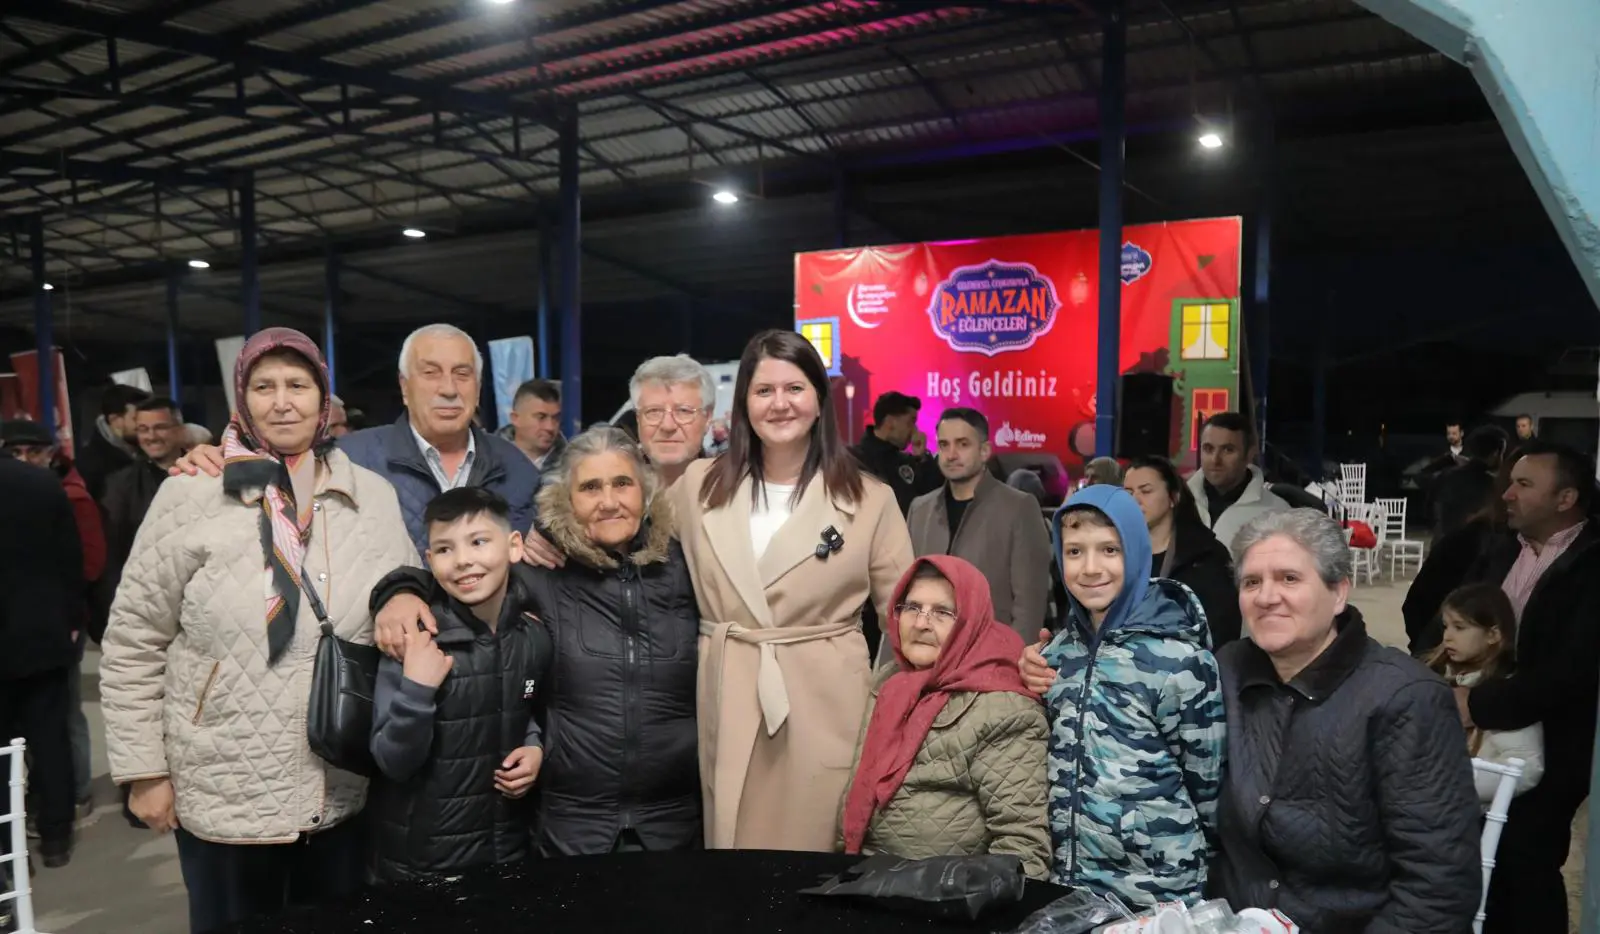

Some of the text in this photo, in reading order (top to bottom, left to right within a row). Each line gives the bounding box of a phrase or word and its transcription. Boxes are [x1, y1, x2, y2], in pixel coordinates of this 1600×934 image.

[941, 287, 1047, 327] RAMAZAN
[958, 316, 1027, 333] EĞLENCELERİ
[927, 369, 1058, 404] Hoş Geldiniz
[1014, 428, 1046, 442] Edirne
